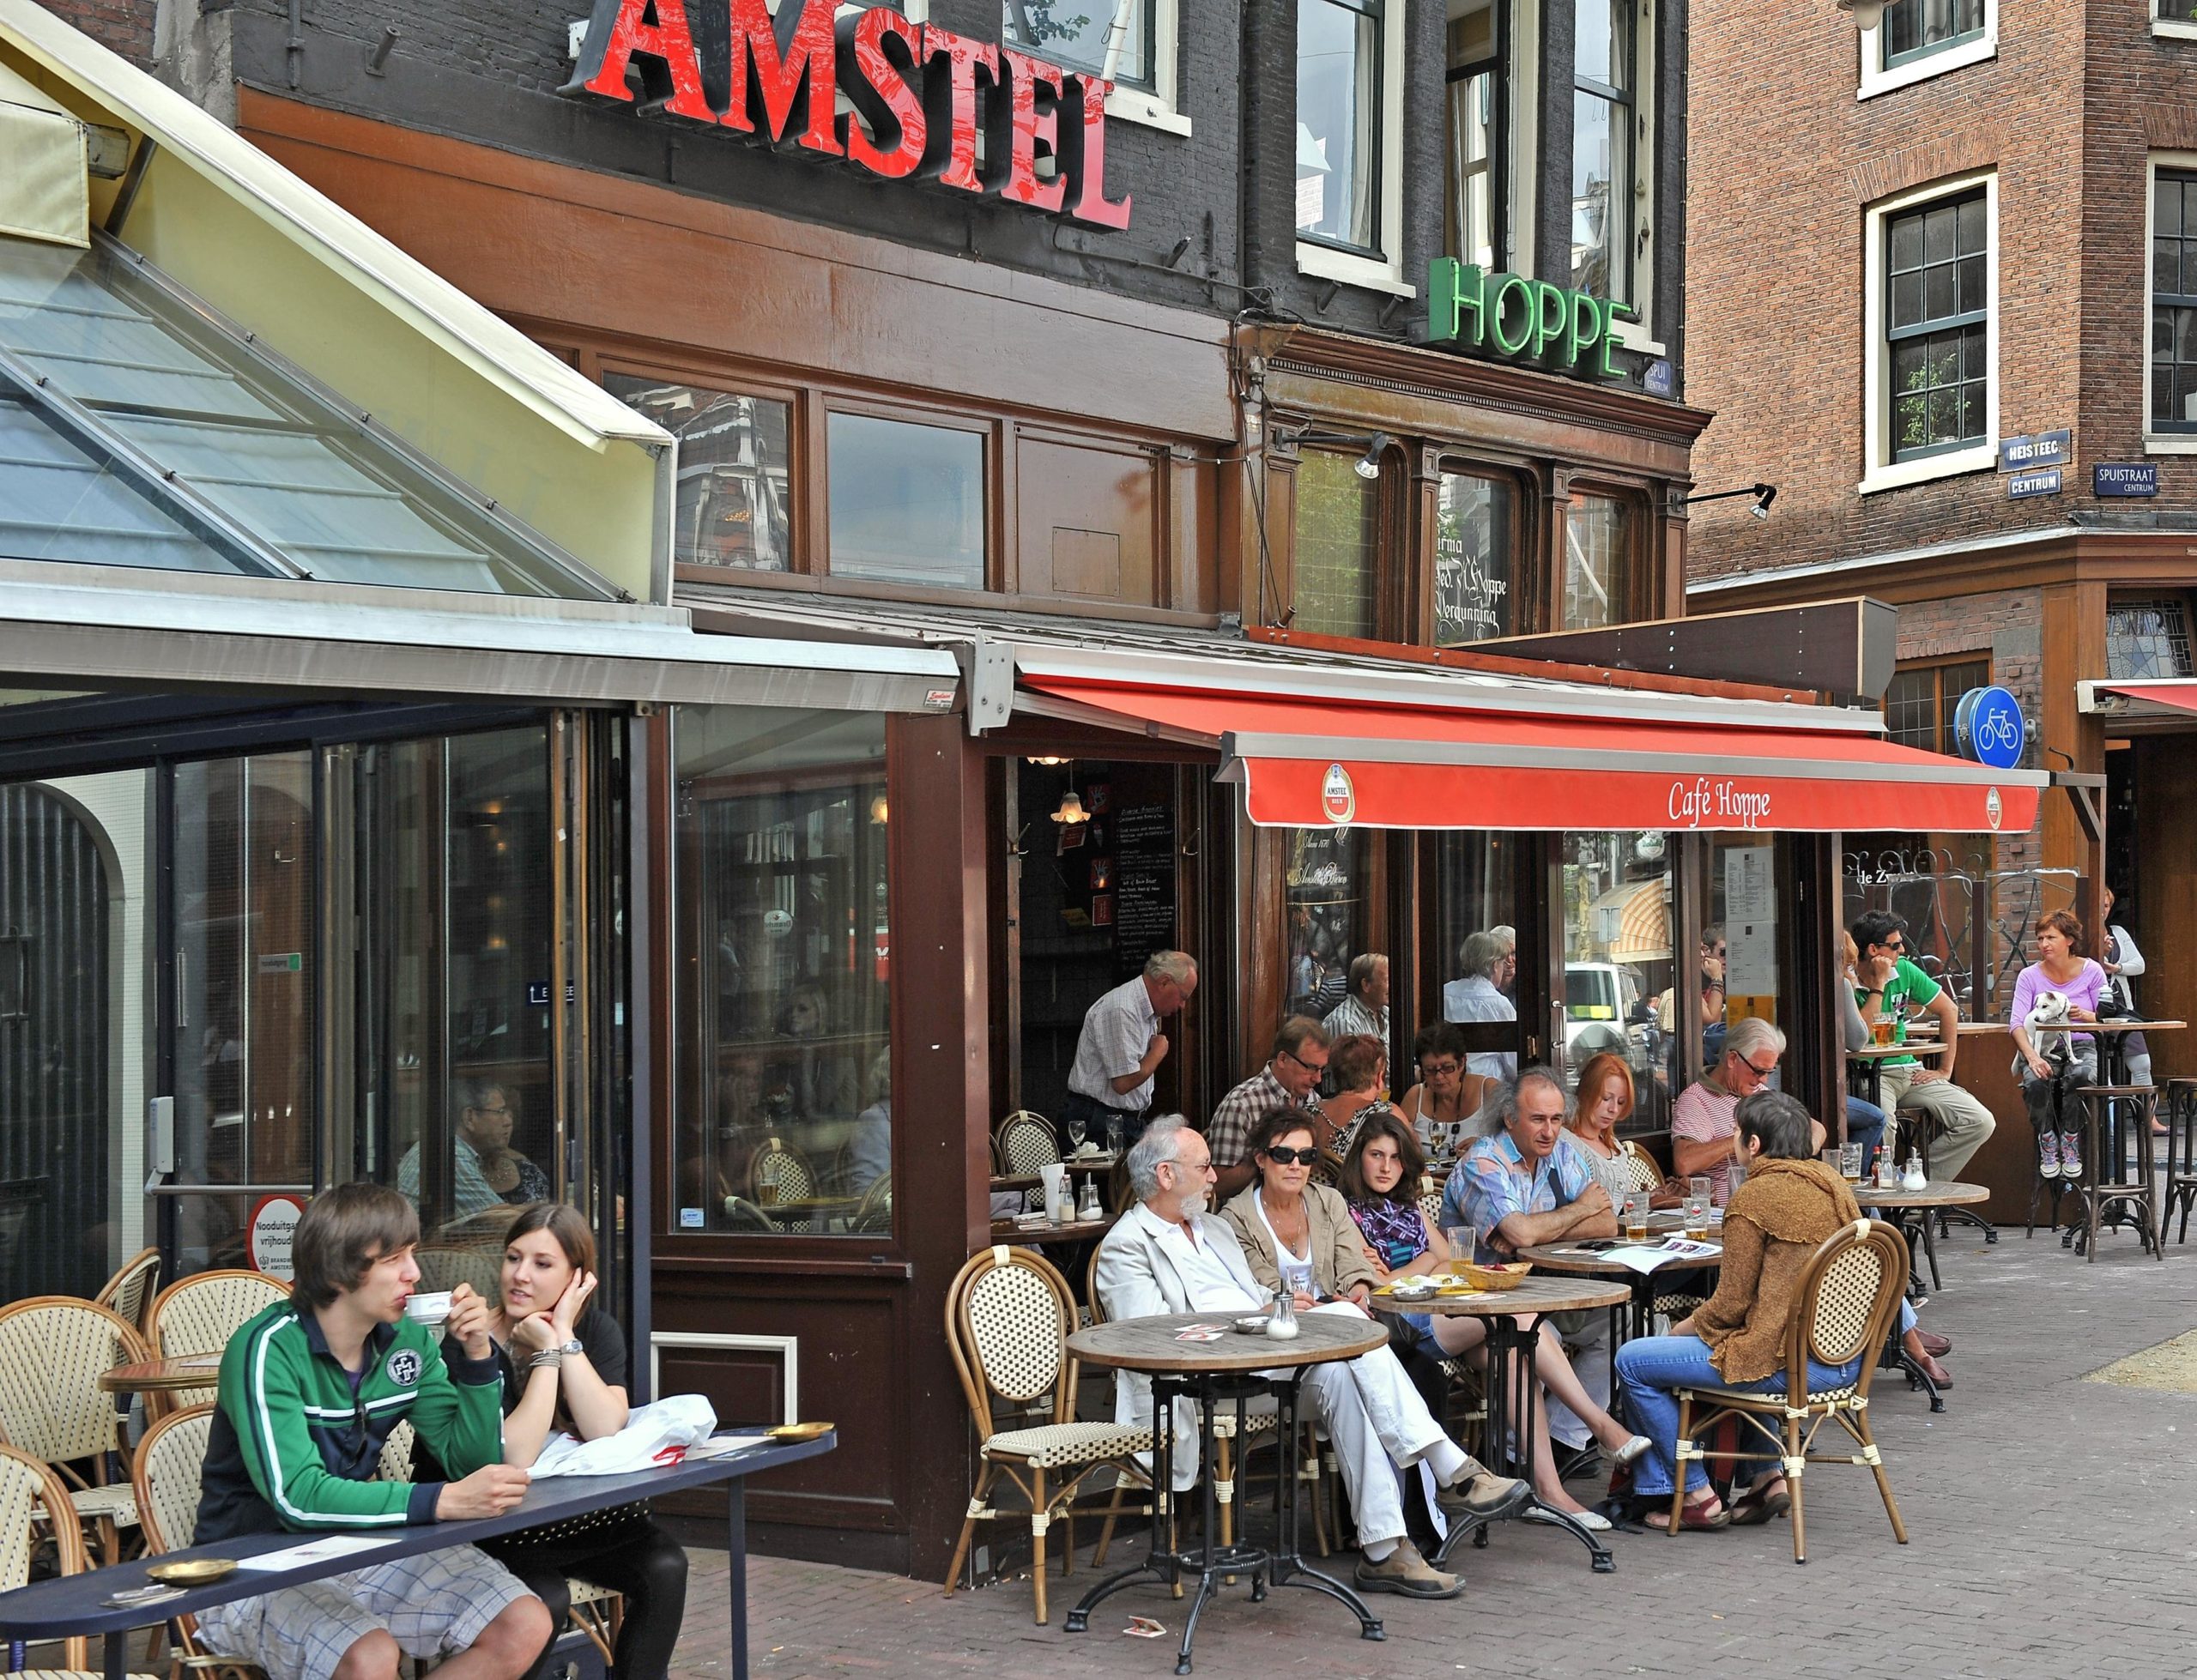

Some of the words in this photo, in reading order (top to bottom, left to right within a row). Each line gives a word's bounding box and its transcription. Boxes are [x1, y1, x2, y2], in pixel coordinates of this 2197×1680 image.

[584, 0, 1132, 231] AMSTEL
[1442, 257, 1632, 379] HOPPE
[1649, 362, 1666, 380] SPUI
[1647, 379, 1669, 393] CENTRUM
[2099, 468, 2154, 482] SPUISTRAAT
[2012, 475, 2056, 494] CENTRUM
[2123, 483, 2154, 493] CENTRUM
[1437, 535, 1462, 554] irma
[1435, 589, 1500, 636] Vergunning
[1327, 787, 1347, 796] AMSTEL
[1668, 777, 1711, 829] Café
[1715, 781, 1771, 830] Hoppe
[1856, 869, 1873, 885] de
[256, 1220, 296, 1233] Nooduitga
[260, 1236, 292, 1248] vrijhoud
